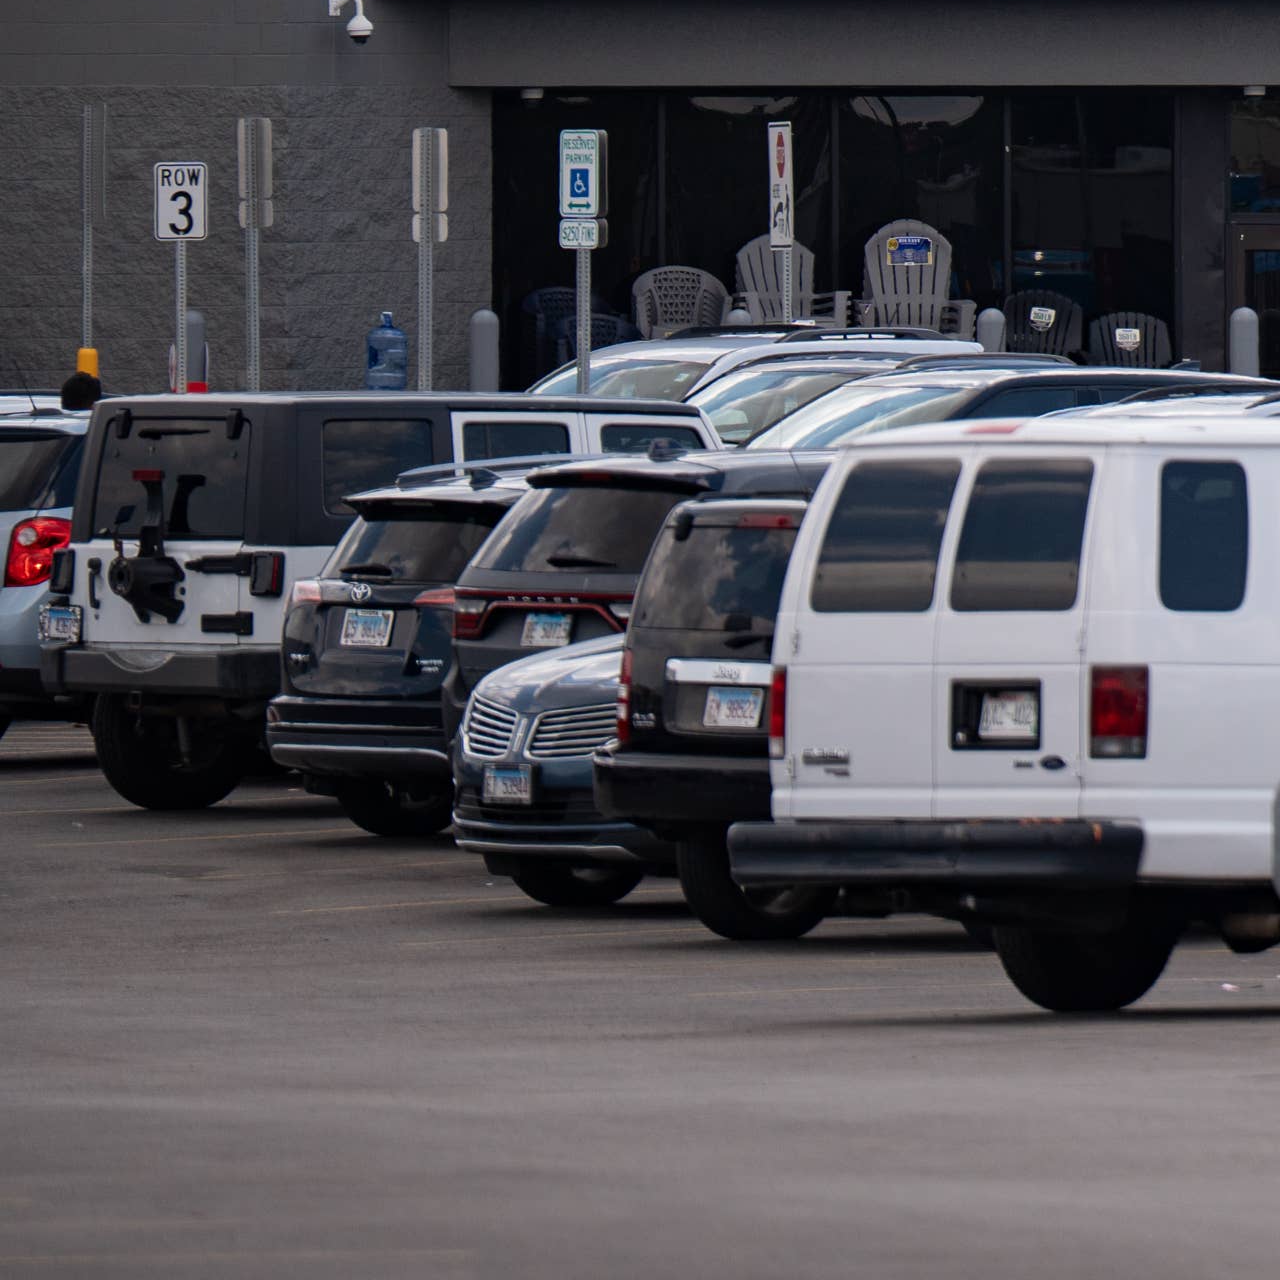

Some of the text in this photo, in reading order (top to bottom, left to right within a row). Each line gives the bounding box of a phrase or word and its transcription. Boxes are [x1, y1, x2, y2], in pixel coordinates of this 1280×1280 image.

[563, 138, 595, 150] RESERVED
[565, 153, 593, 164] PARKING
[161, 168, 200, 187] ROW
[168, 190, 194, 235] 3
[581, 225, 595, 242] FINE
